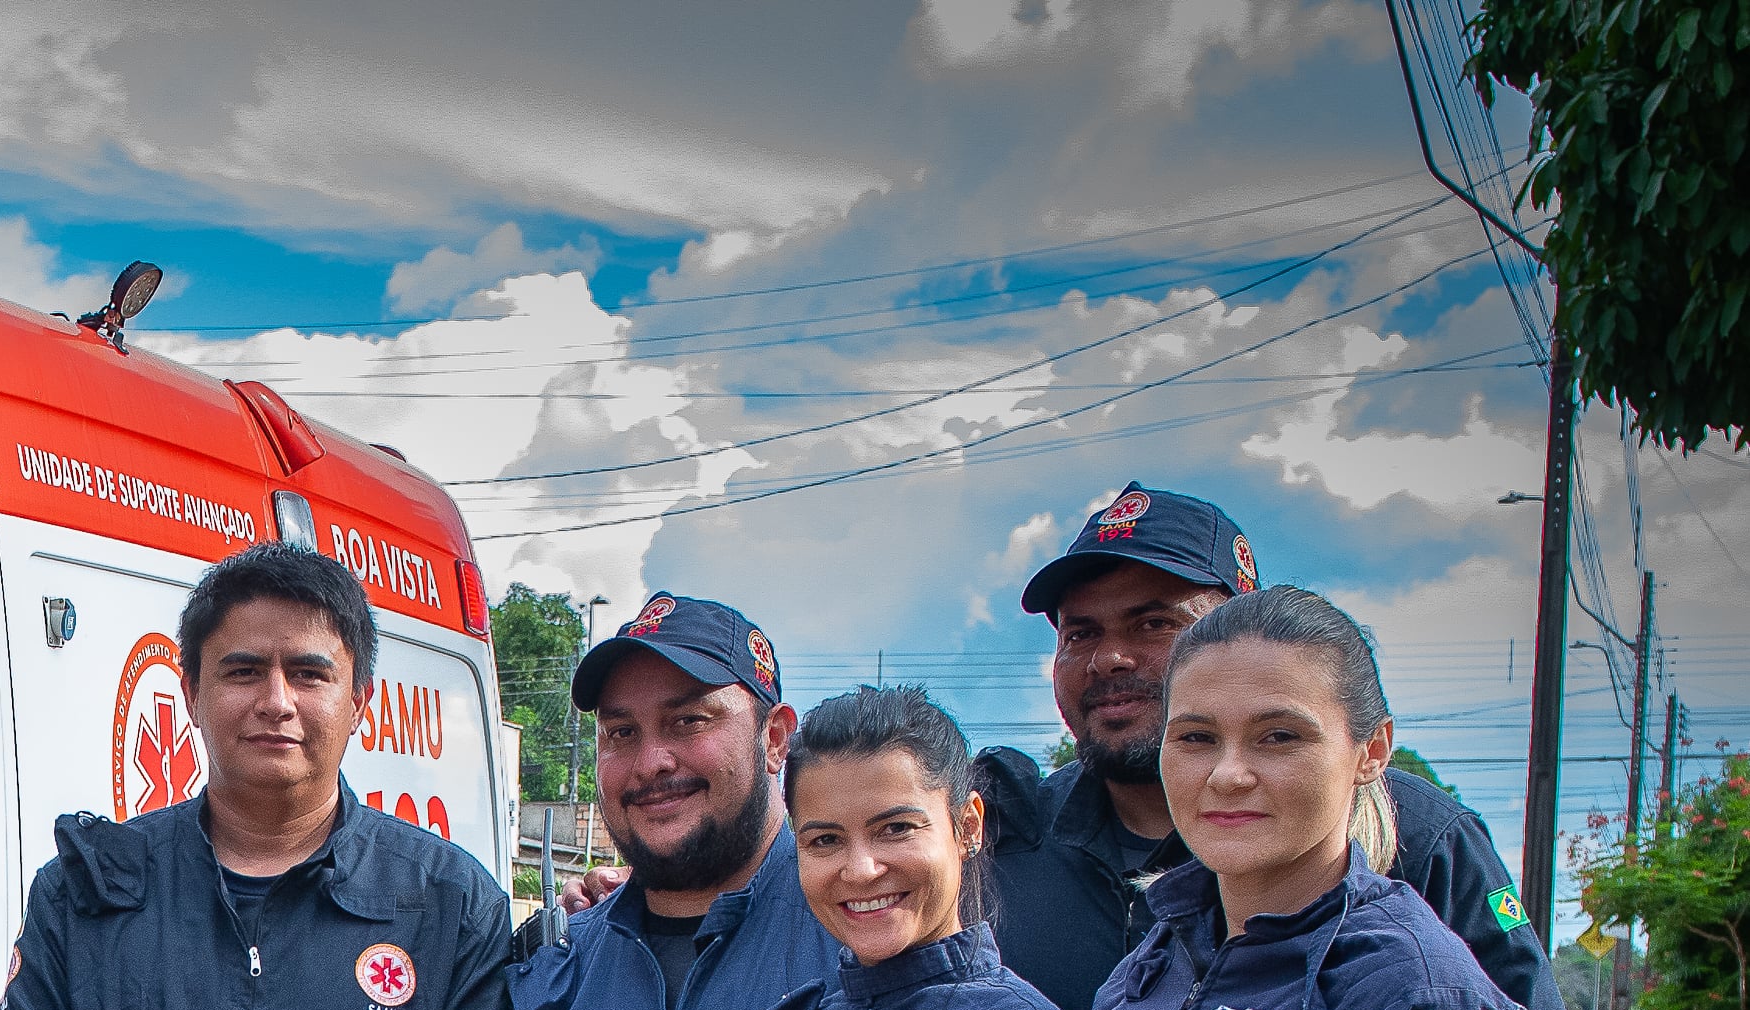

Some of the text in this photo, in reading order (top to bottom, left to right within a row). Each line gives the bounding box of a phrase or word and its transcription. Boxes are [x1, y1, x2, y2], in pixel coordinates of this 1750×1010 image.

[16, 443, 256, 545] UNIDADE DE SUPORTE AVANÇADO
[1097, 527, 1133, 542] 192
[330, 524, 442, 610] BOA VISTA
[118, 694, 129, 718] DE
[123, 643, 171, 694] ATENDIMENTO
[360, 678, 443, 760] SAMU
[115, 726, 124, 808] SERVIÇO
